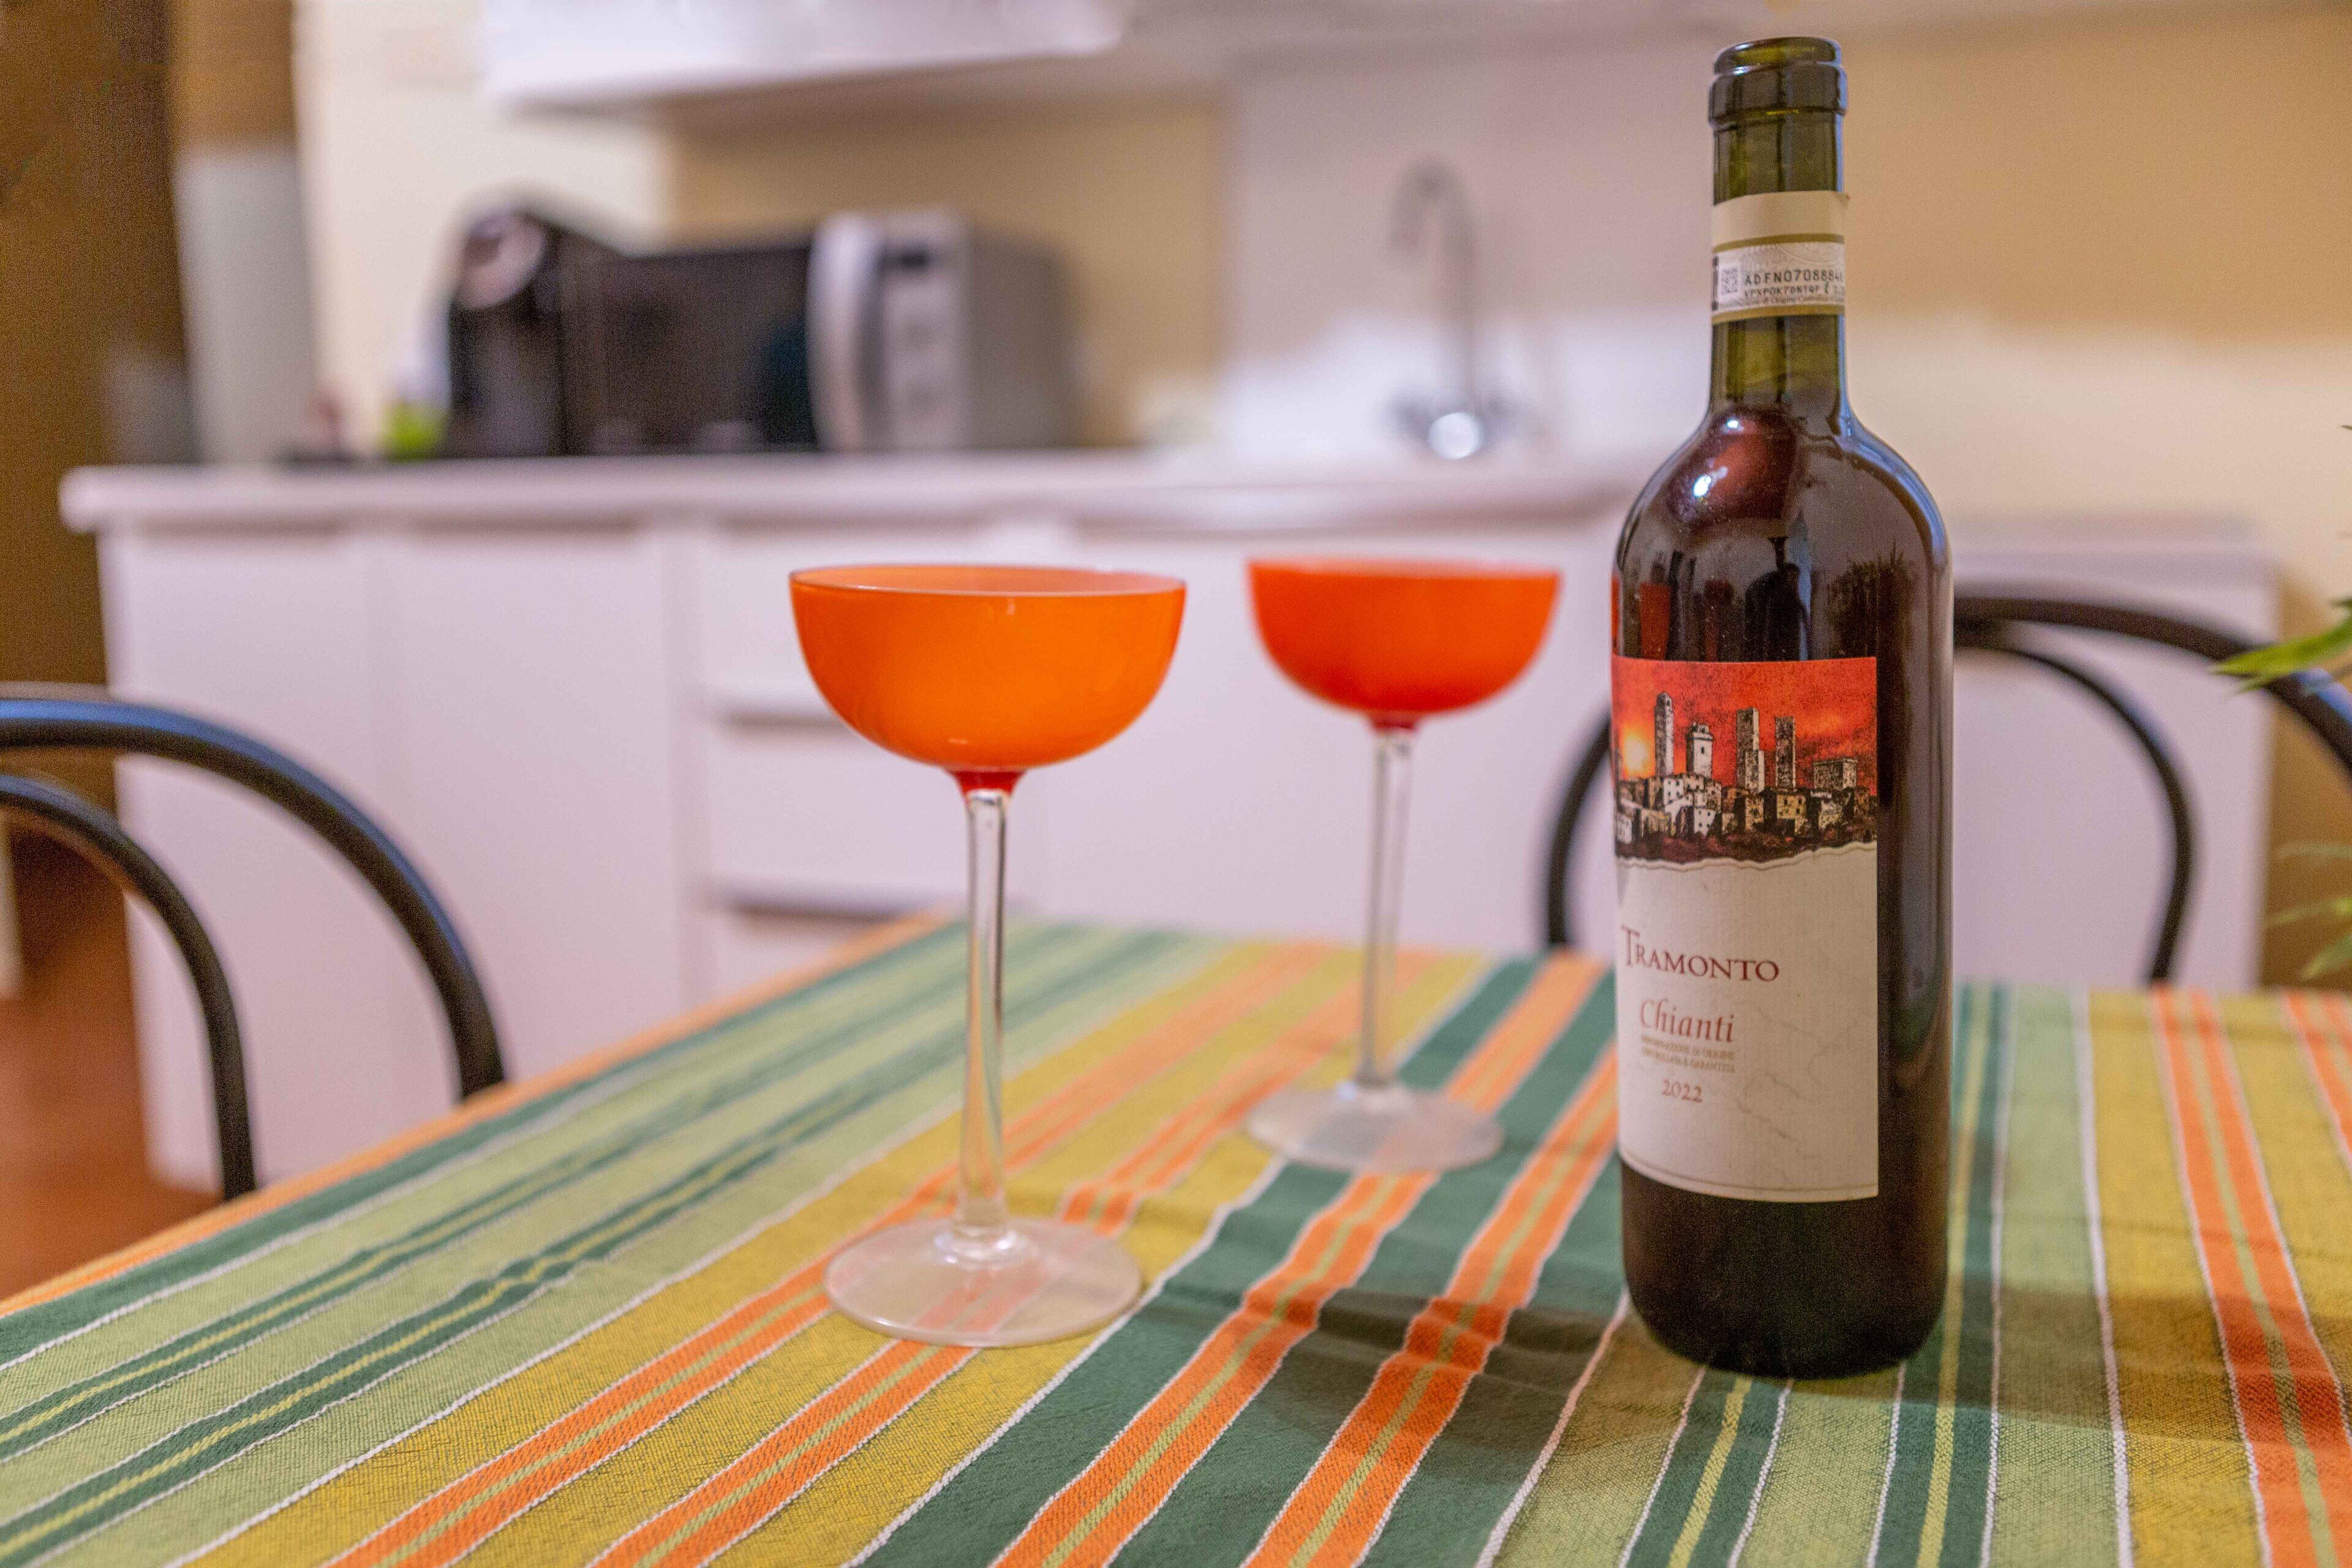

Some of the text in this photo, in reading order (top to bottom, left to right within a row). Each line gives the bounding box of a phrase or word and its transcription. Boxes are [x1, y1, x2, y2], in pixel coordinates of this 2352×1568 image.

[1621, 924, 1780, 982] TRAMONTO
[1641, 998, 1735, 1042] Chianti
[1662, 1079, 1703, 1102] 2022
